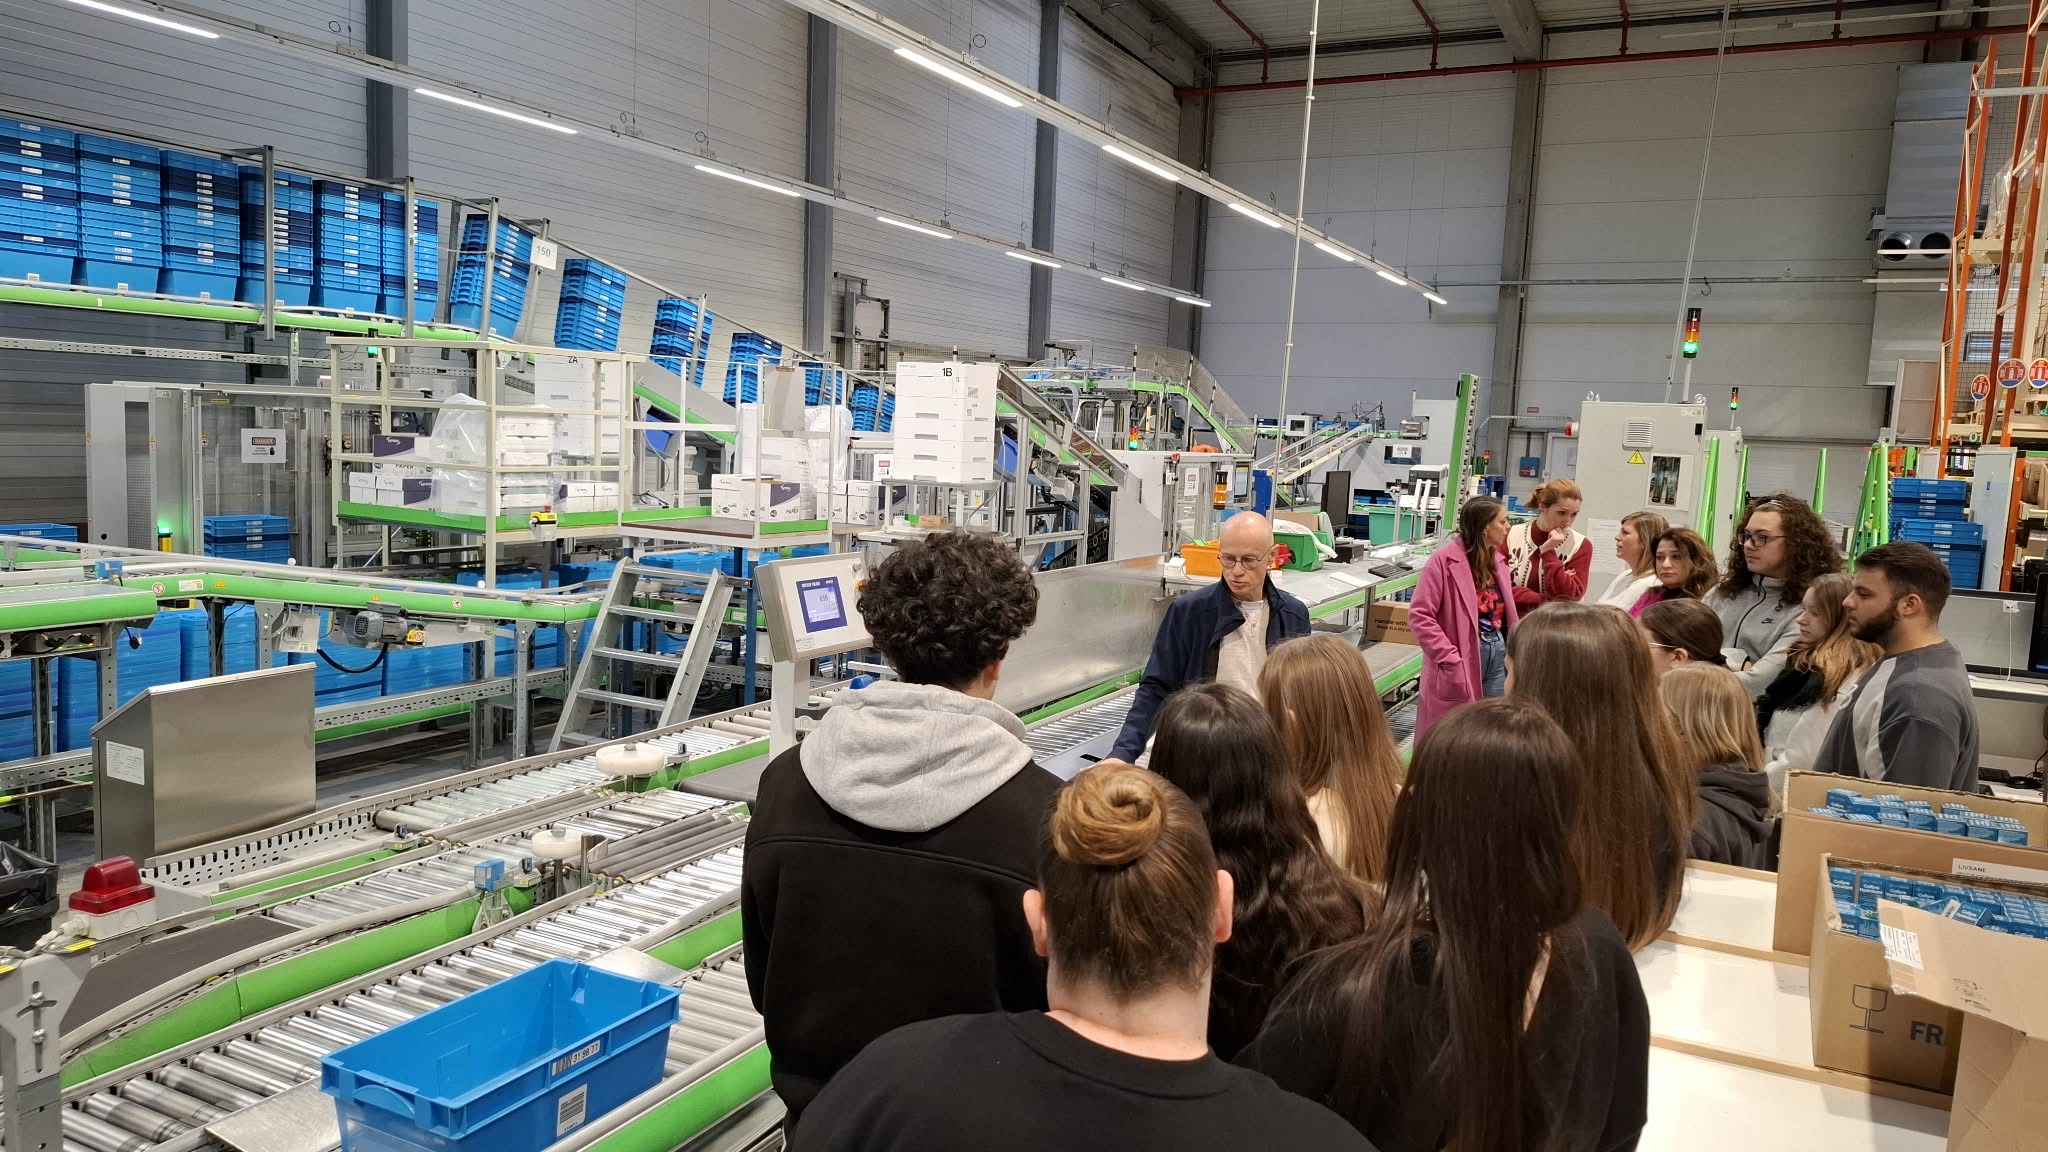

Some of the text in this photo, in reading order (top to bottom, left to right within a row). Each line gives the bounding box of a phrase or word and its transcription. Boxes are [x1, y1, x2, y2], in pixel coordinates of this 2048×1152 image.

[537, 245, 551, 257] 150
[942, 367, 953, 377] 1B
[1958, 864, 1987, 873] LIVSANE
[1910, 1020, 1945, 1047] FR
[582, 1047, 590, 1059] 98
